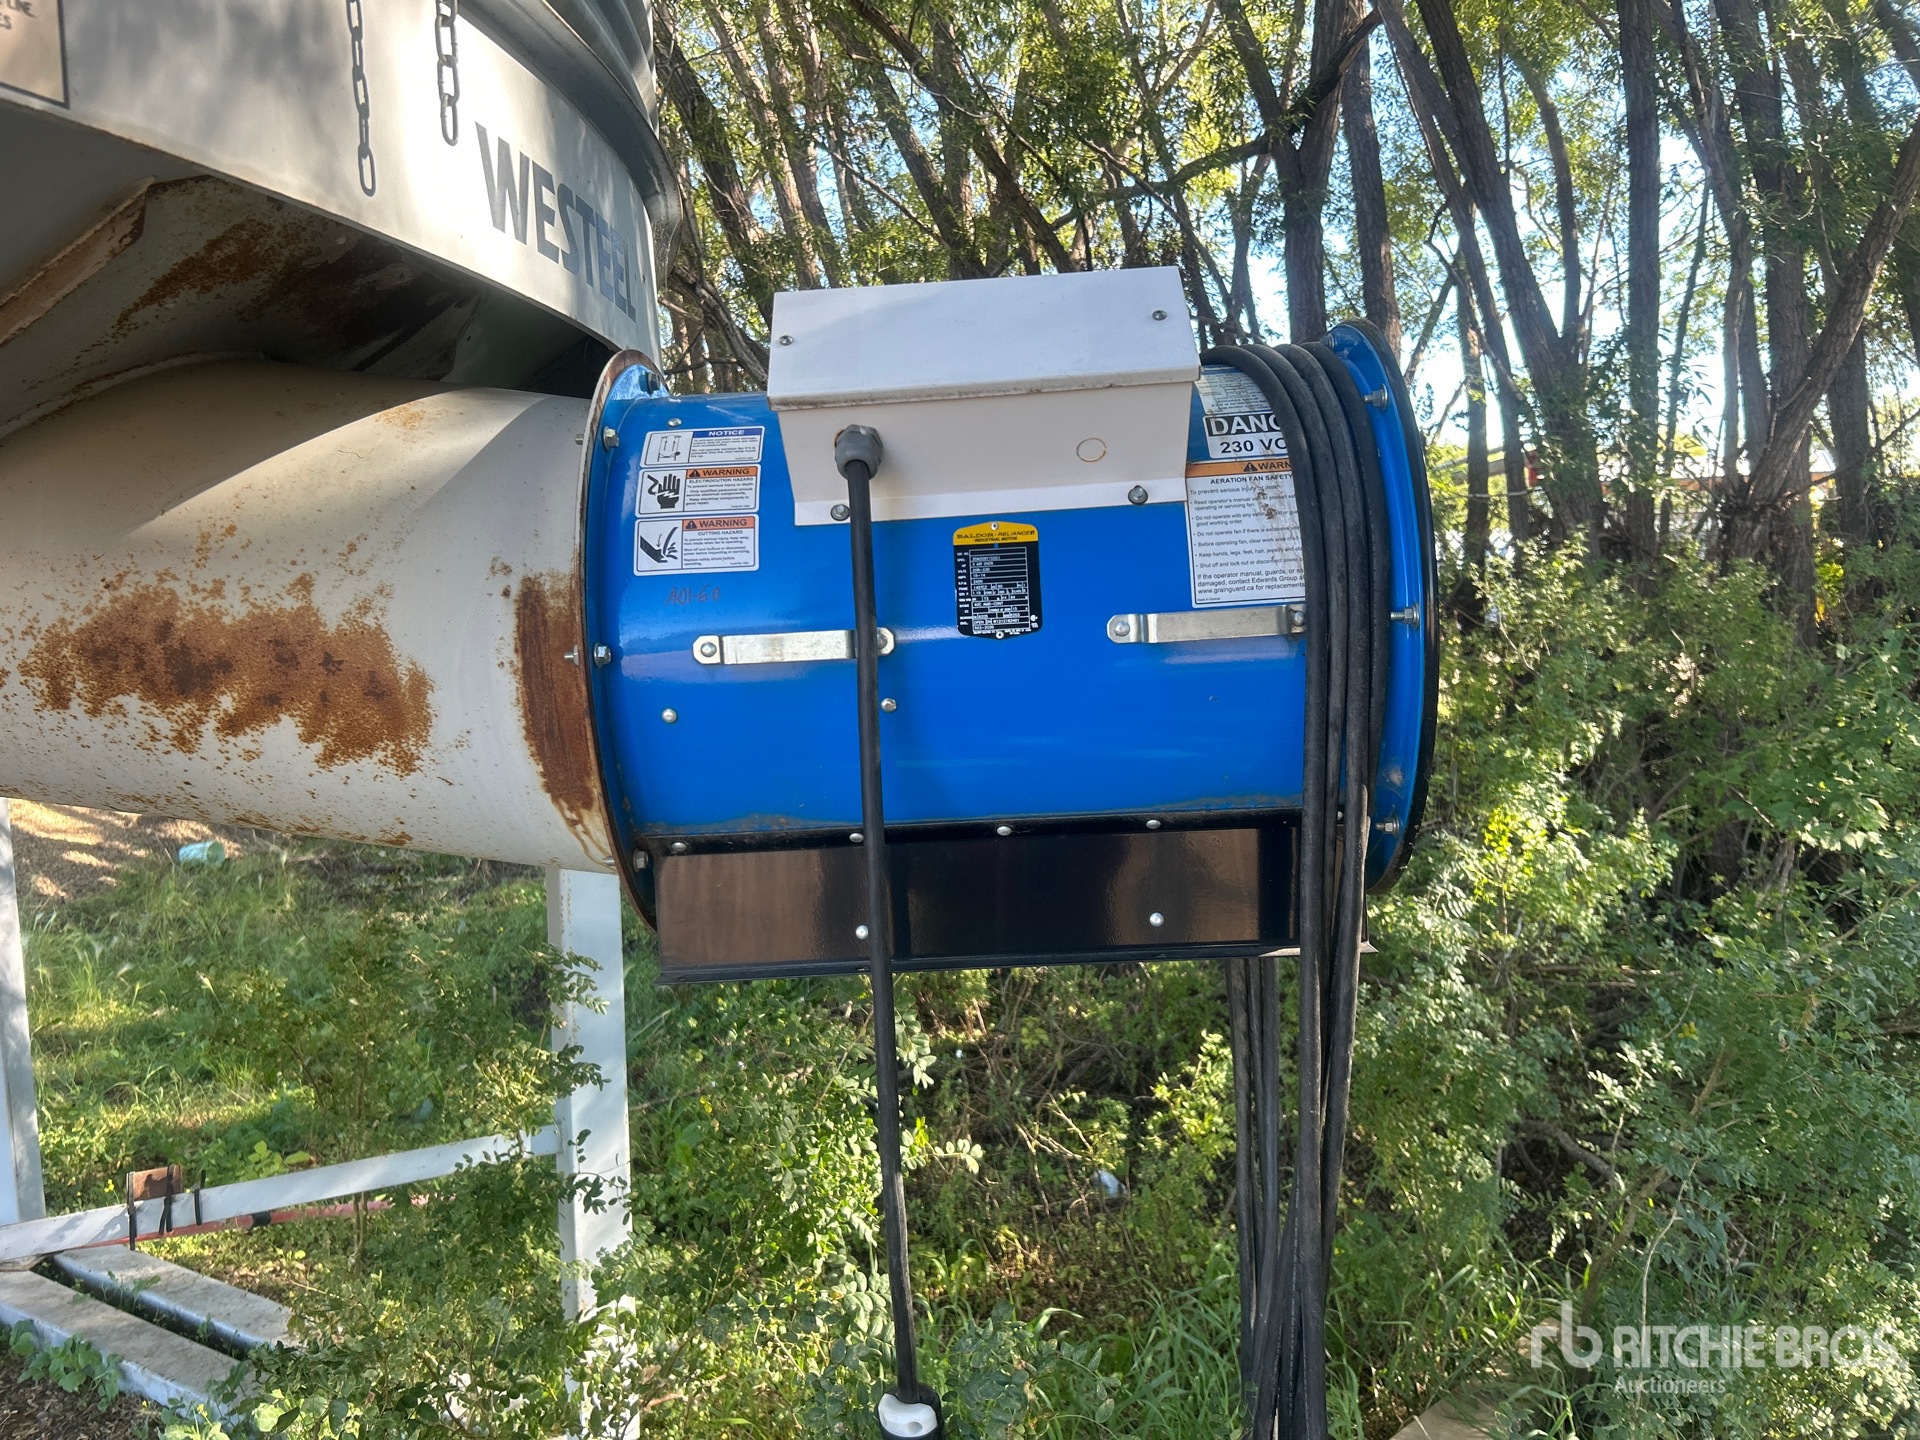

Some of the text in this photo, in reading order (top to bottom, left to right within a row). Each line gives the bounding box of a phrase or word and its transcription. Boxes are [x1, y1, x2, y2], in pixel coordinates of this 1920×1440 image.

[475, 121, 636, 323] WESTEEL
[1220, 440, 1254, 453] 230
[702, 468, 750, 476] WARNING
[1210, 476, 1247, 484] AERATION
[699, 519, 747, 528] WARNING
[1213, 572, 1239, 580] operator
[1197, 580, 1227, 588] damaged,
[1251, 576, 1278, 584] Edwards
[1197, 586, 1255, 595] www.grainguard.ca
[1264, 582, 1306, 590] replacements
